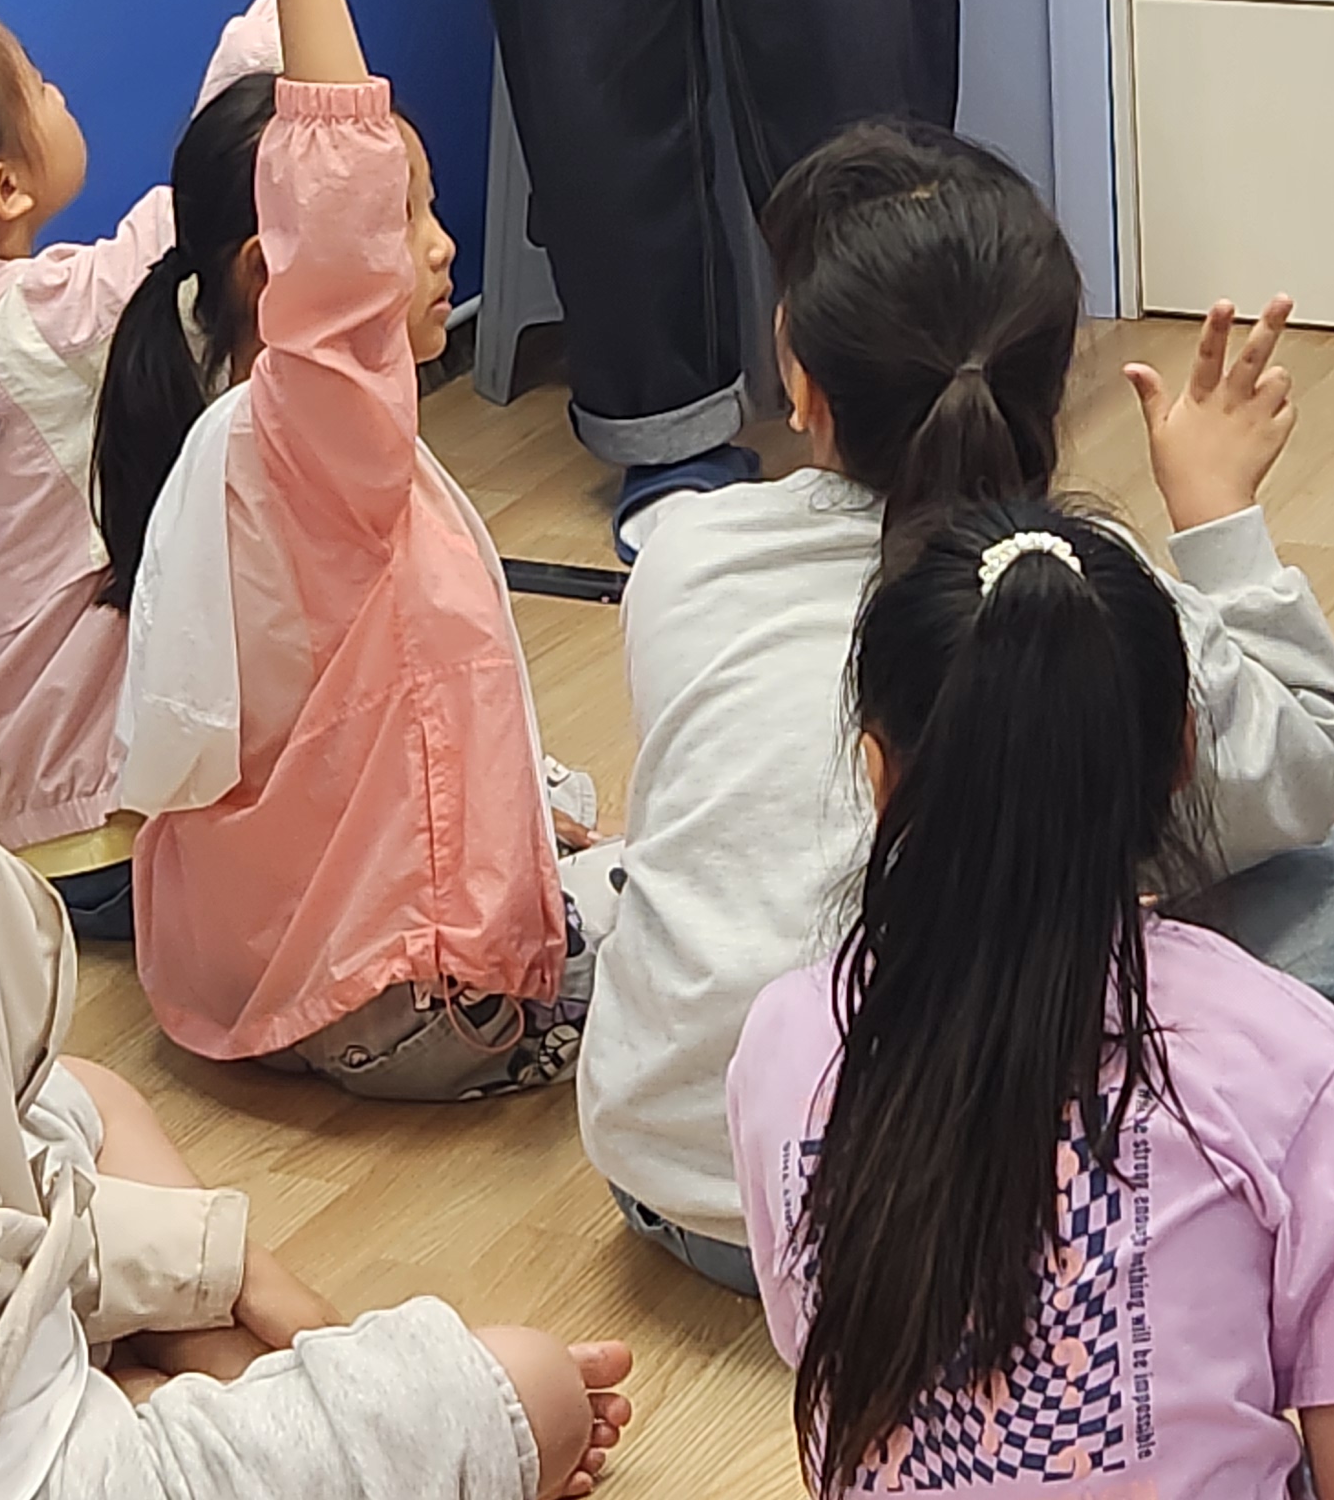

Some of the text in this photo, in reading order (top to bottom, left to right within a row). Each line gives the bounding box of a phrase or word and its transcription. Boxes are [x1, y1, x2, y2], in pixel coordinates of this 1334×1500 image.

[1129, 1139, 1152, 1190] strong
[1127, 1252, 1150, 1311] nothing
[1131, 1314, 1152, 1344] will
[1133, 1348, 1154, 1369] be
[1131, 1373, 1157, 1460] impossible
